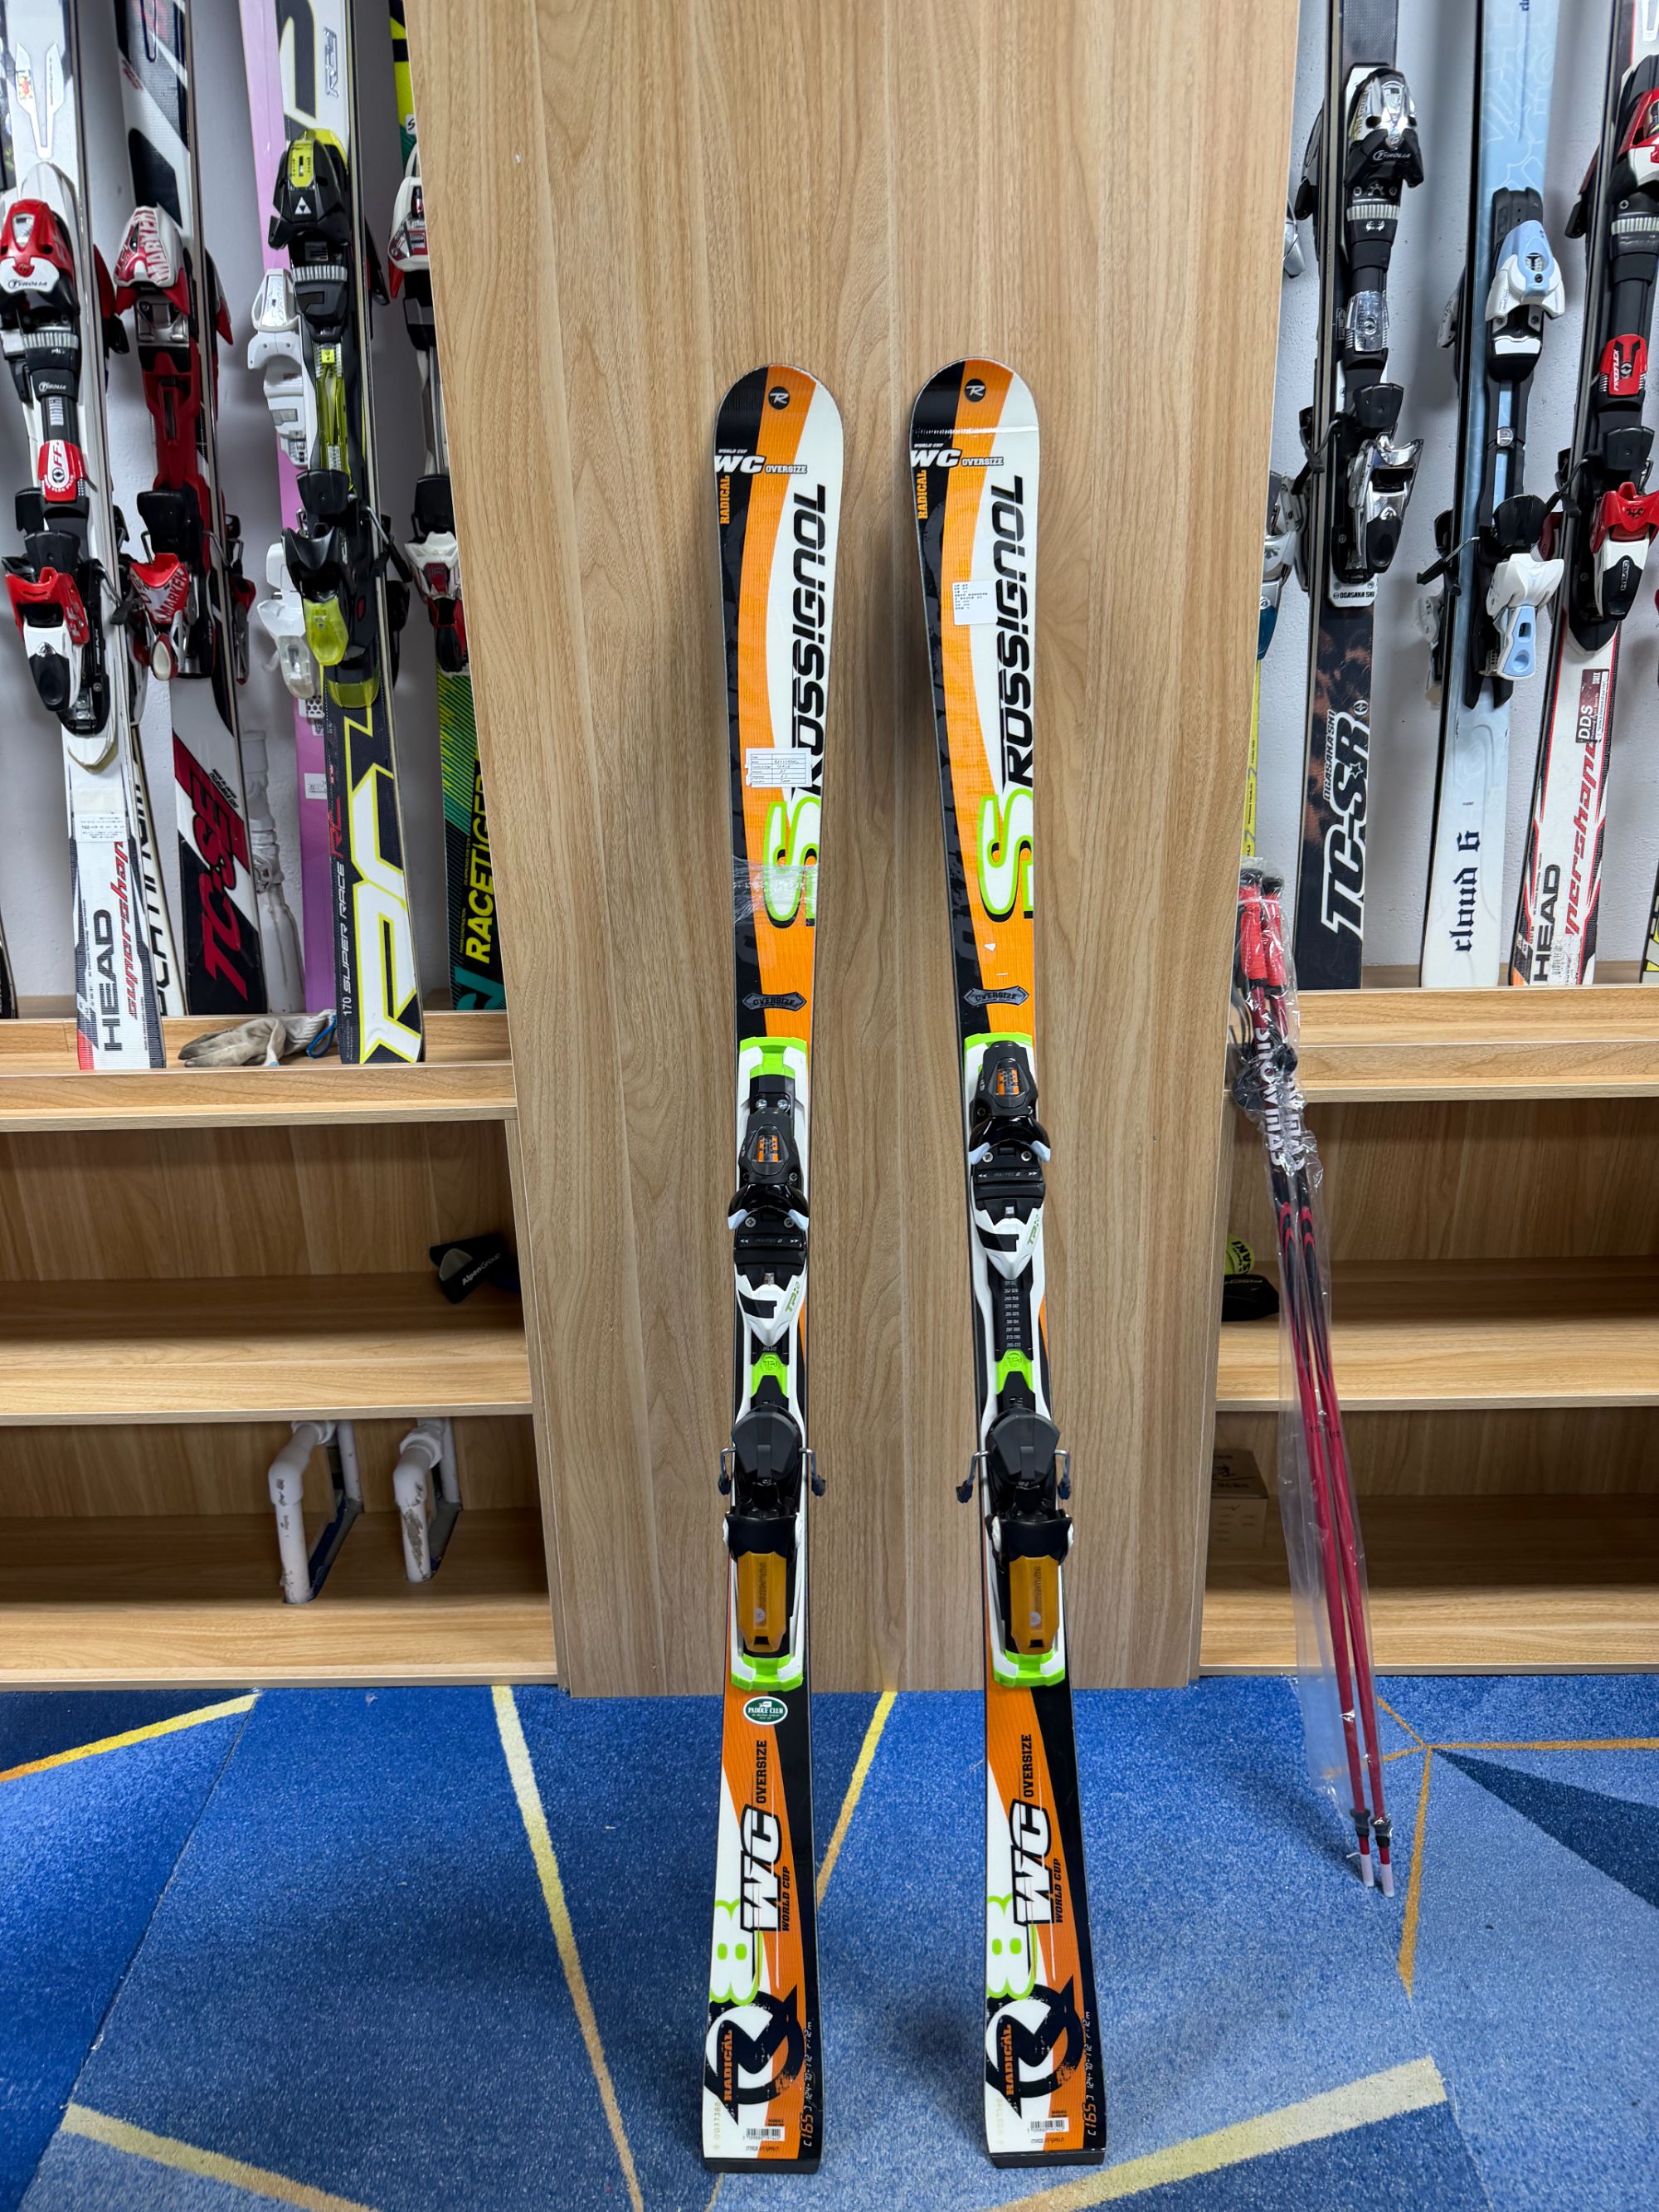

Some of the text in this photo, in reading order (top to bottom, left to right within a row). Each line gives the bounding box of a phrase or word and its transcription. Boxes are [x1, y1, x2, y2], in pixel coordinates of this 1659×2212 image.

[714, 456, 807, 474] WC OVERSIZE
[910, 449, 1004, 467] WC OVERSIZE
[719, 475, 730, 524] RADICAL
[916, 470, 928, 519] RADICAL
[990, 475, 1034, 792] ROSSIGNOL
[338, 860, 347, 919] RACE
[1449, 867, 1478, 952] cloud
[1533, 864, 1560, 982] HEAD
[110, 841, 138, 1020] supershap
[338, 922, 351, 994] SUPER
[93, 909, 123, 1051] HEAD
[343, 996, 352, 1016] 170
[752, 996, 795, 1006] OVERSIZE
[756, 1740, 766, 1804] OVERSIZE
[1021, 1734, 1034, 1798] OVERSIZE
[740, 1803, 782, 1933] WC
[1010, 1798, 1054, 1927] WC
[1053, 1859, 1063, 1924] WORLD CUP
[781, 1865, 790, 1932] WORLD CUP
[722, 2029, 732, 2102] RADICAL
[1002, 2024, 1014, 2096] RADICAL
